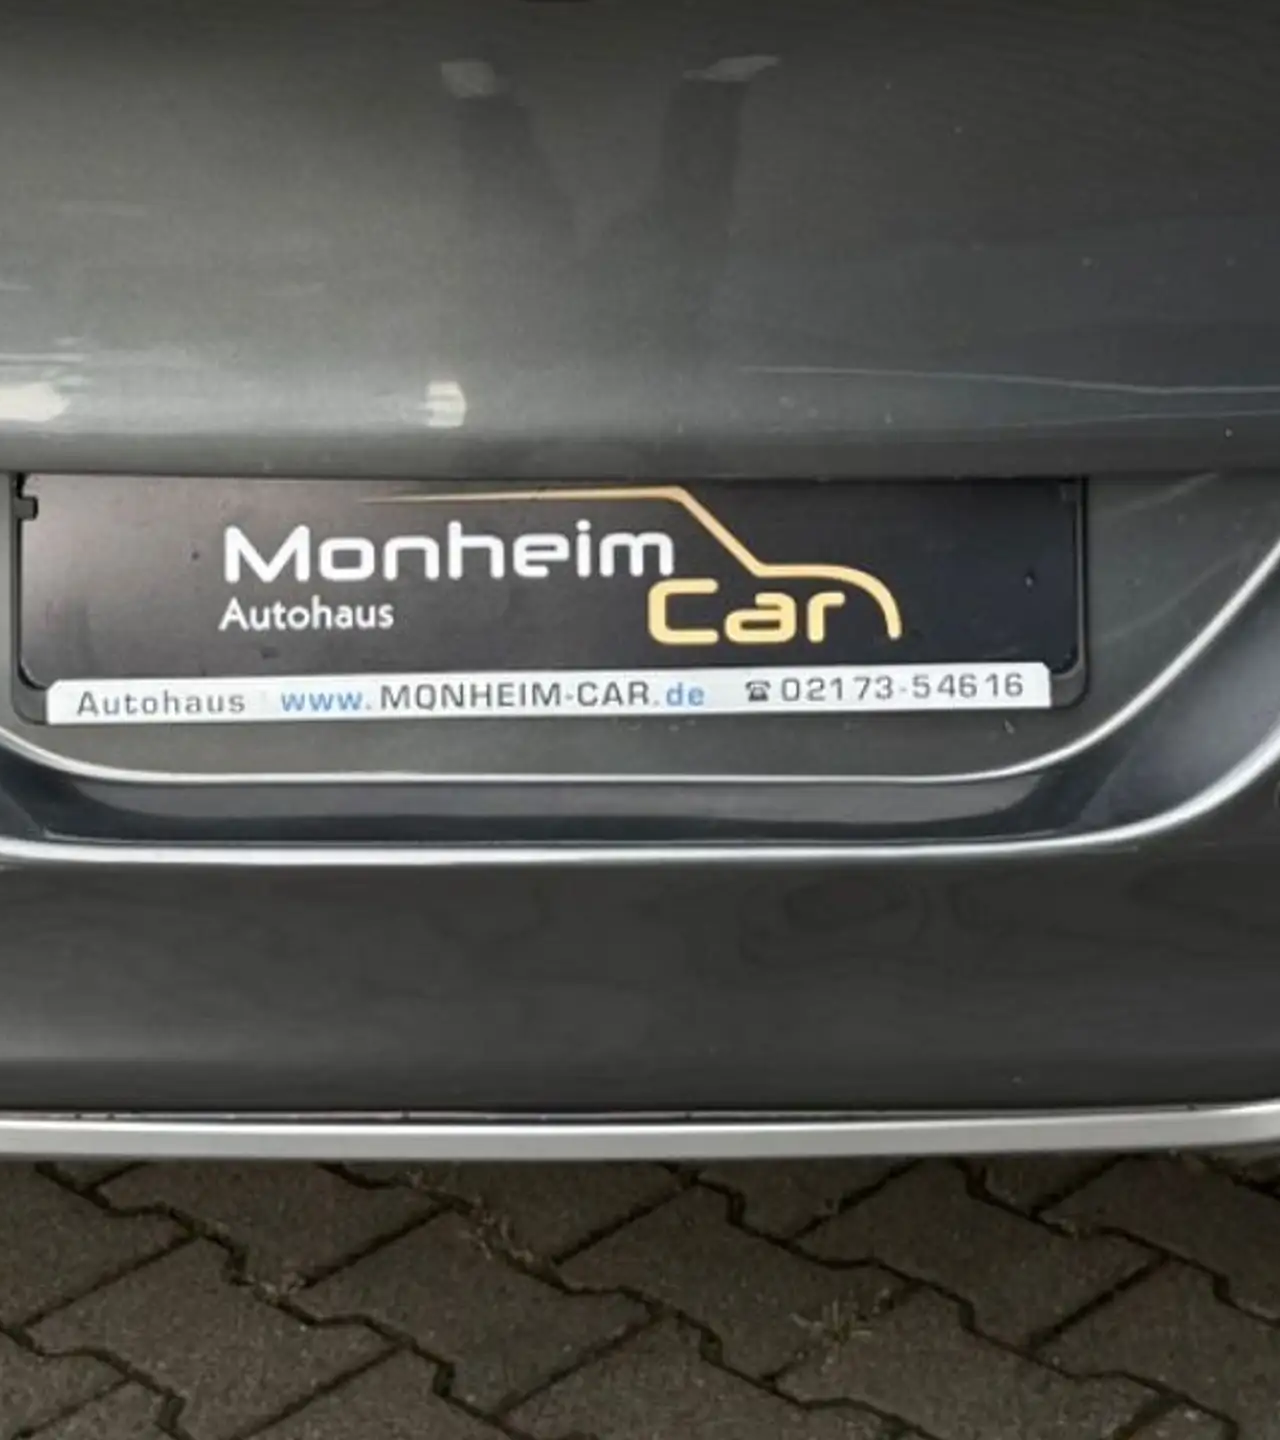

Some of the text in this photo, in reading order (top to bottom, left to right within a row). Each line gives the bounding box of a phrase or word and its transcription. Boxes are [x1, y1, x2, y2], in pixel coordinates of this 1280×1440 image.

[224, 520, 674, 583] Monheim
[219, 597, 394, 633] Autohaus
[647, 578, 846, 645] Car
[77, 690, 246, 716] Autohaus
[780, 672, 1025, 703] 02173-54616
